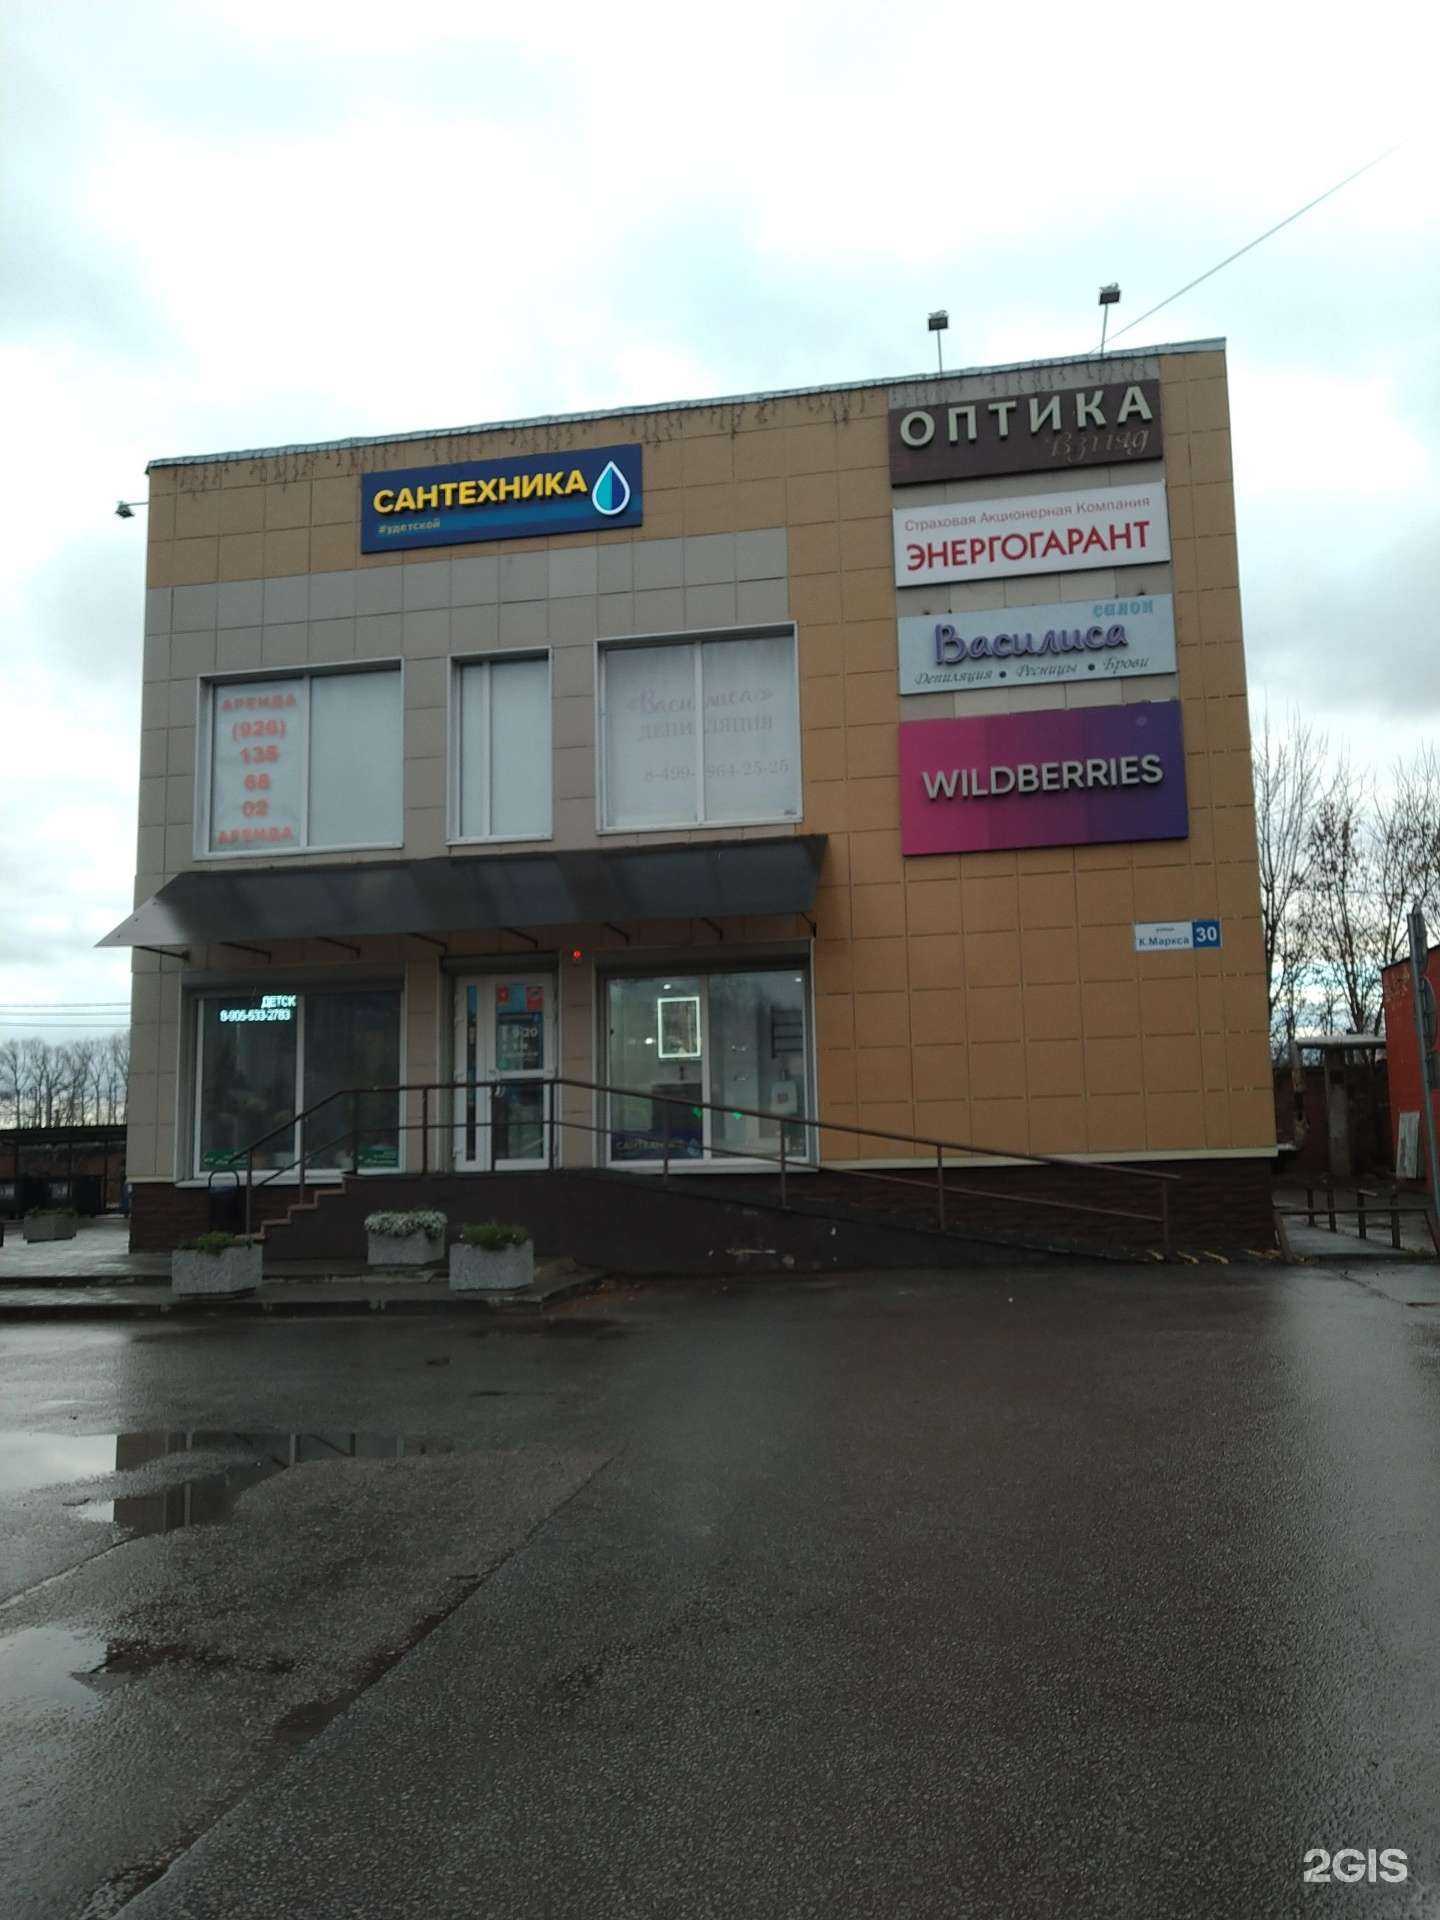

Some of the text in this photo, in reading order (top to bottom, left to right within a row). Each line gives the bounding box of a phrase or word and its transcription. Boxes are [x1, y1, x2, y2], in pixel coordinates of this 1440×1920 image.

[900, 386, 1153, 446] ОПТИКА
[373, 469, 588, 513] САНТЕХНИКА
[904, 496, 1151, 533] Страховая Акционерная Компания
[907, 521, 1151, 572] ЭНЕРГОГАРАНТ
[1093, 599, 1154, 617] салон
[935, 623, 1129, 666] Василиса
[914, 669, 993, 686] Депиляция
[922, 753, 1164, 800] WILDBERRIES
[1196, 926, 1218, 943] 30
